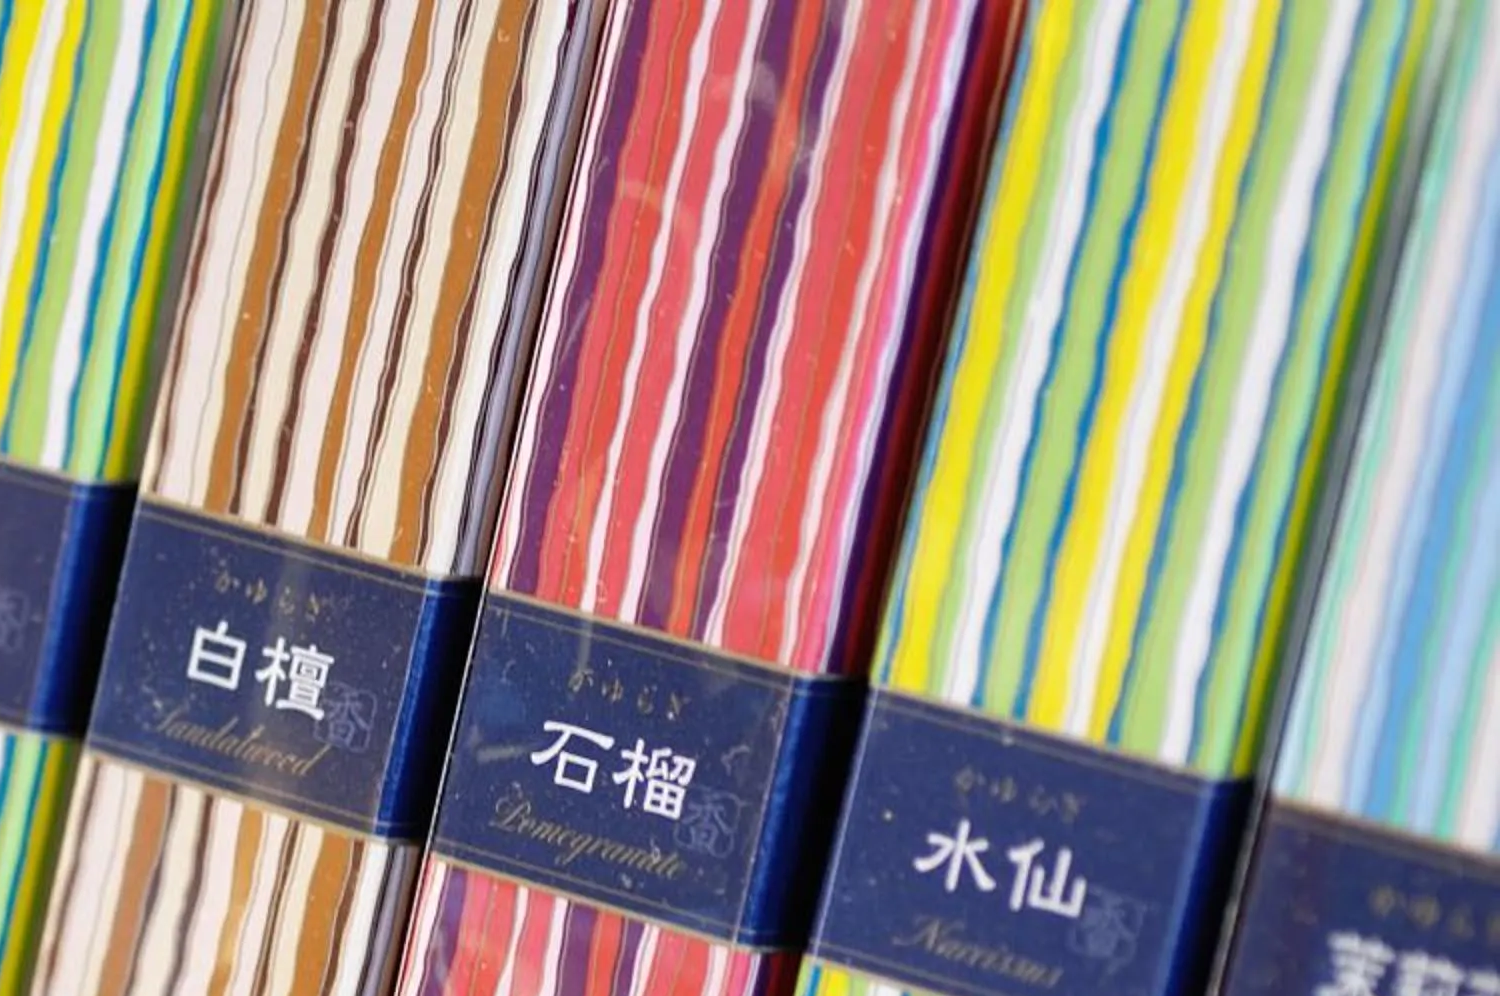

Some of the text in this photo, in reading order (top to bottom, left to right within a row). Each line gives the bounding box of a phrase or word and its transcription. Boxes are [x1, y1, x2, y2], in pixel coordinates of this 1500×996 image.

[186, 619, 336, 722] 白檀
[529, 719, 698, 821] 石榴
[912, 818, 1088, 919] 水仙
